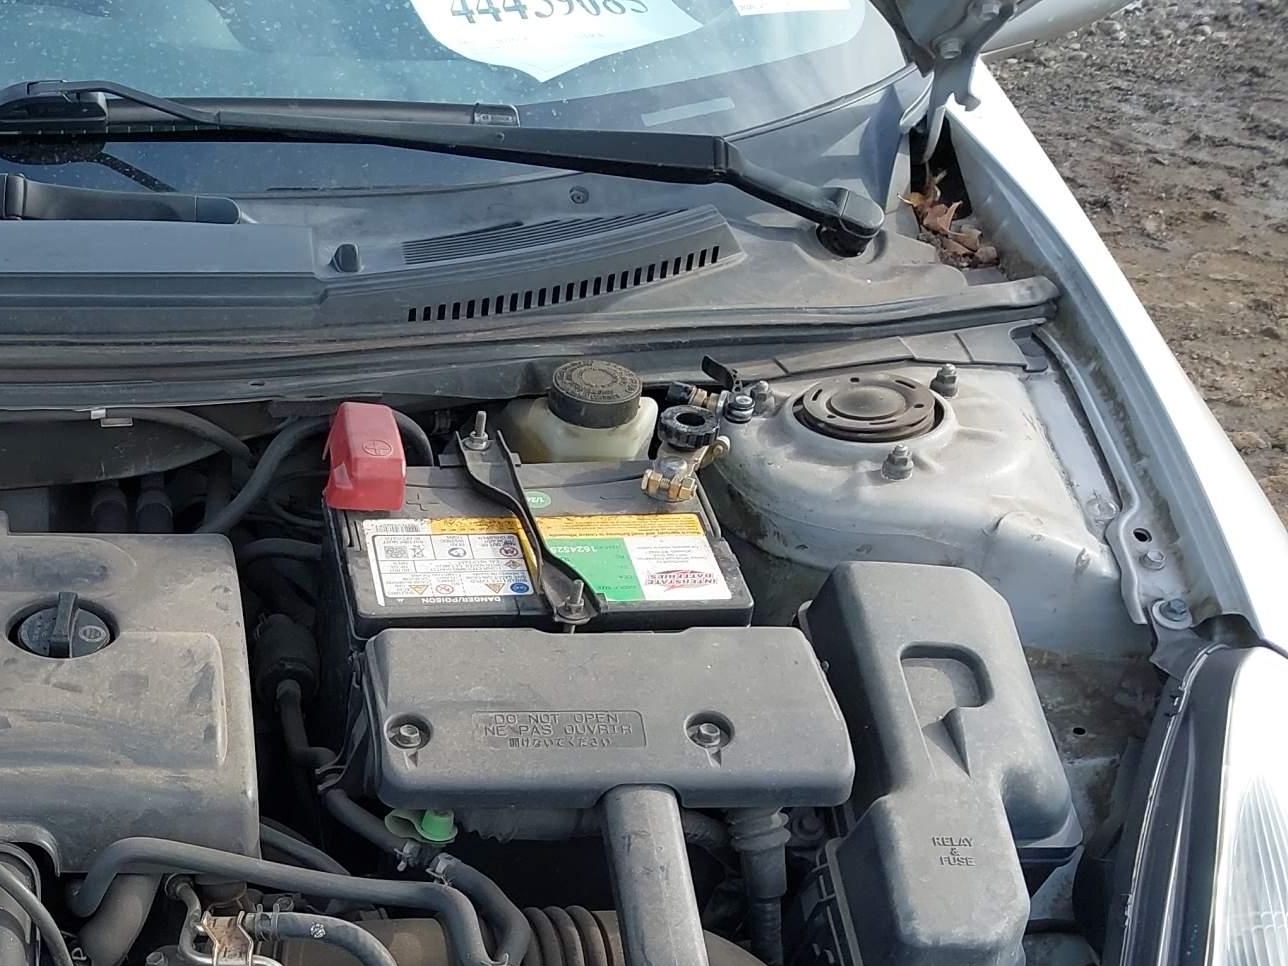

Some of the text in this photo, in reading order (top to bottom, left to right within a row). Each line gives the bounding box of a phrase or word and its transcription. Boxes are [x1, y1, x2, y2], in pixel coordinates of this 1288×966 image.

[494, 713, 619, 724] DO NOT OPEN
[518, 725, 552, 736] PAS
[932, 836, 973, 847] RELAY
[939, 856, 976, 867] FUSE
